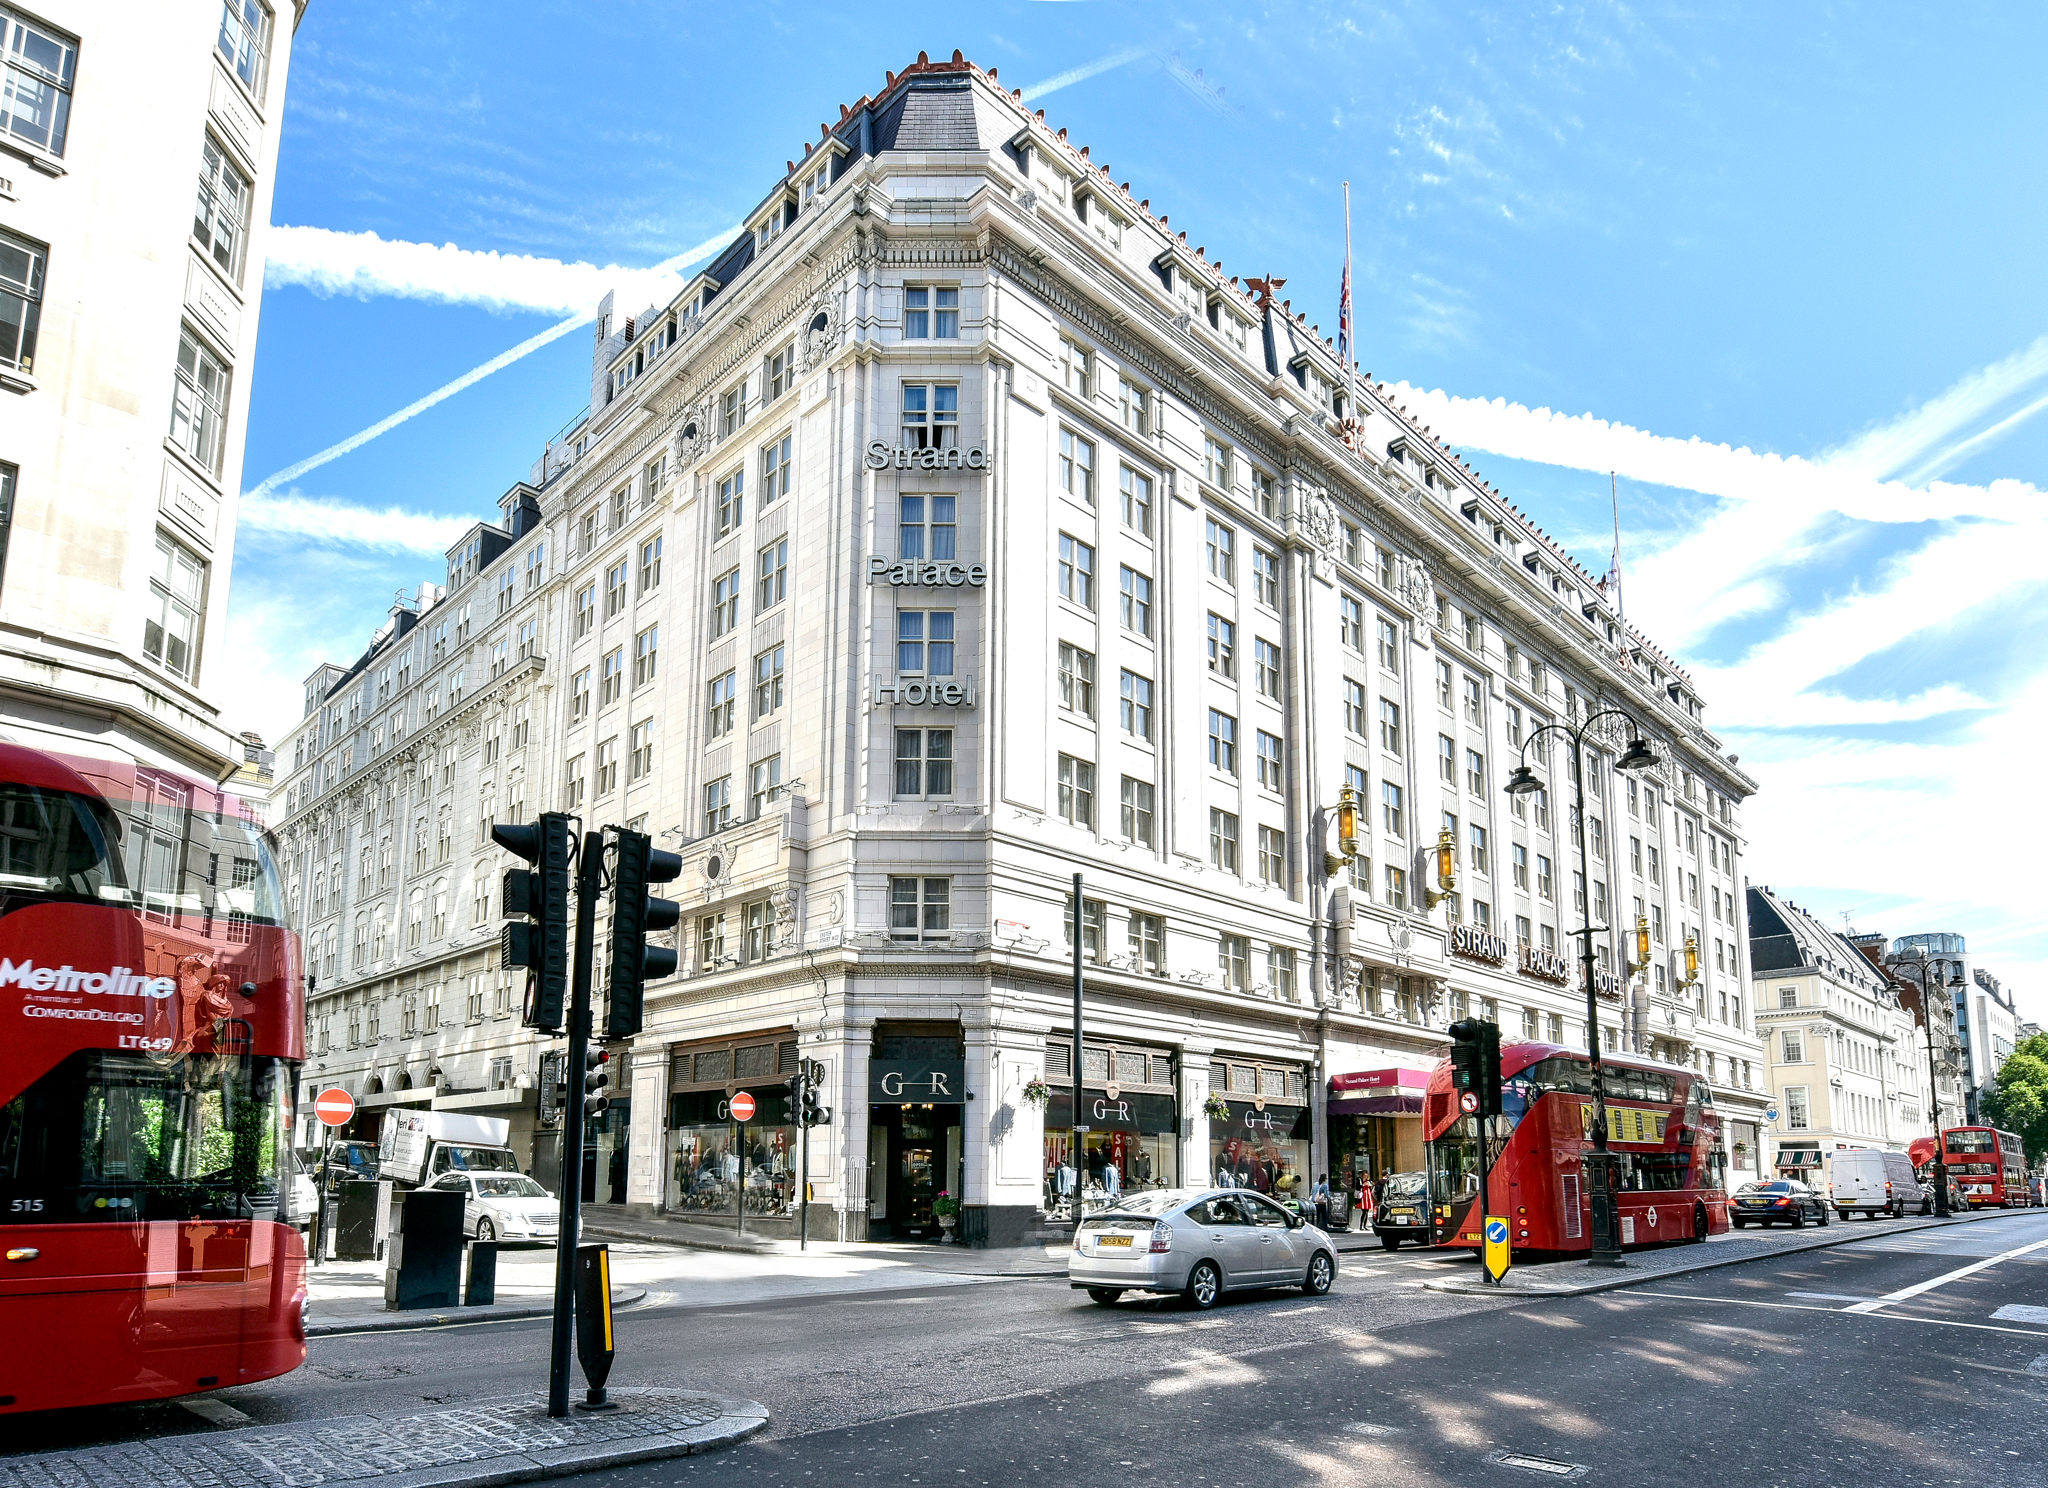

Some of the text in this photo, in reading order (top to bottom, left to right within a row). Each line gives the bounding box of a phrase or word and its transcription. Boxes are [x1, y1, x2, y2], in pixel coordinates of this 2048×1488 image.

[865, 439, 987, 470] Strand
[866, 555, 988, 587] Palace
[874, 673, 973, 706] Hotel
[1455, 924, 1624, 996] STRAND PALACE HOTEL
[0, 957, 177, 999] Metroline
[118, 1034, 173, 1050] LT649
[9, 1199, 45, 1212] 515
[585, 1259, 591, 1269] 9
